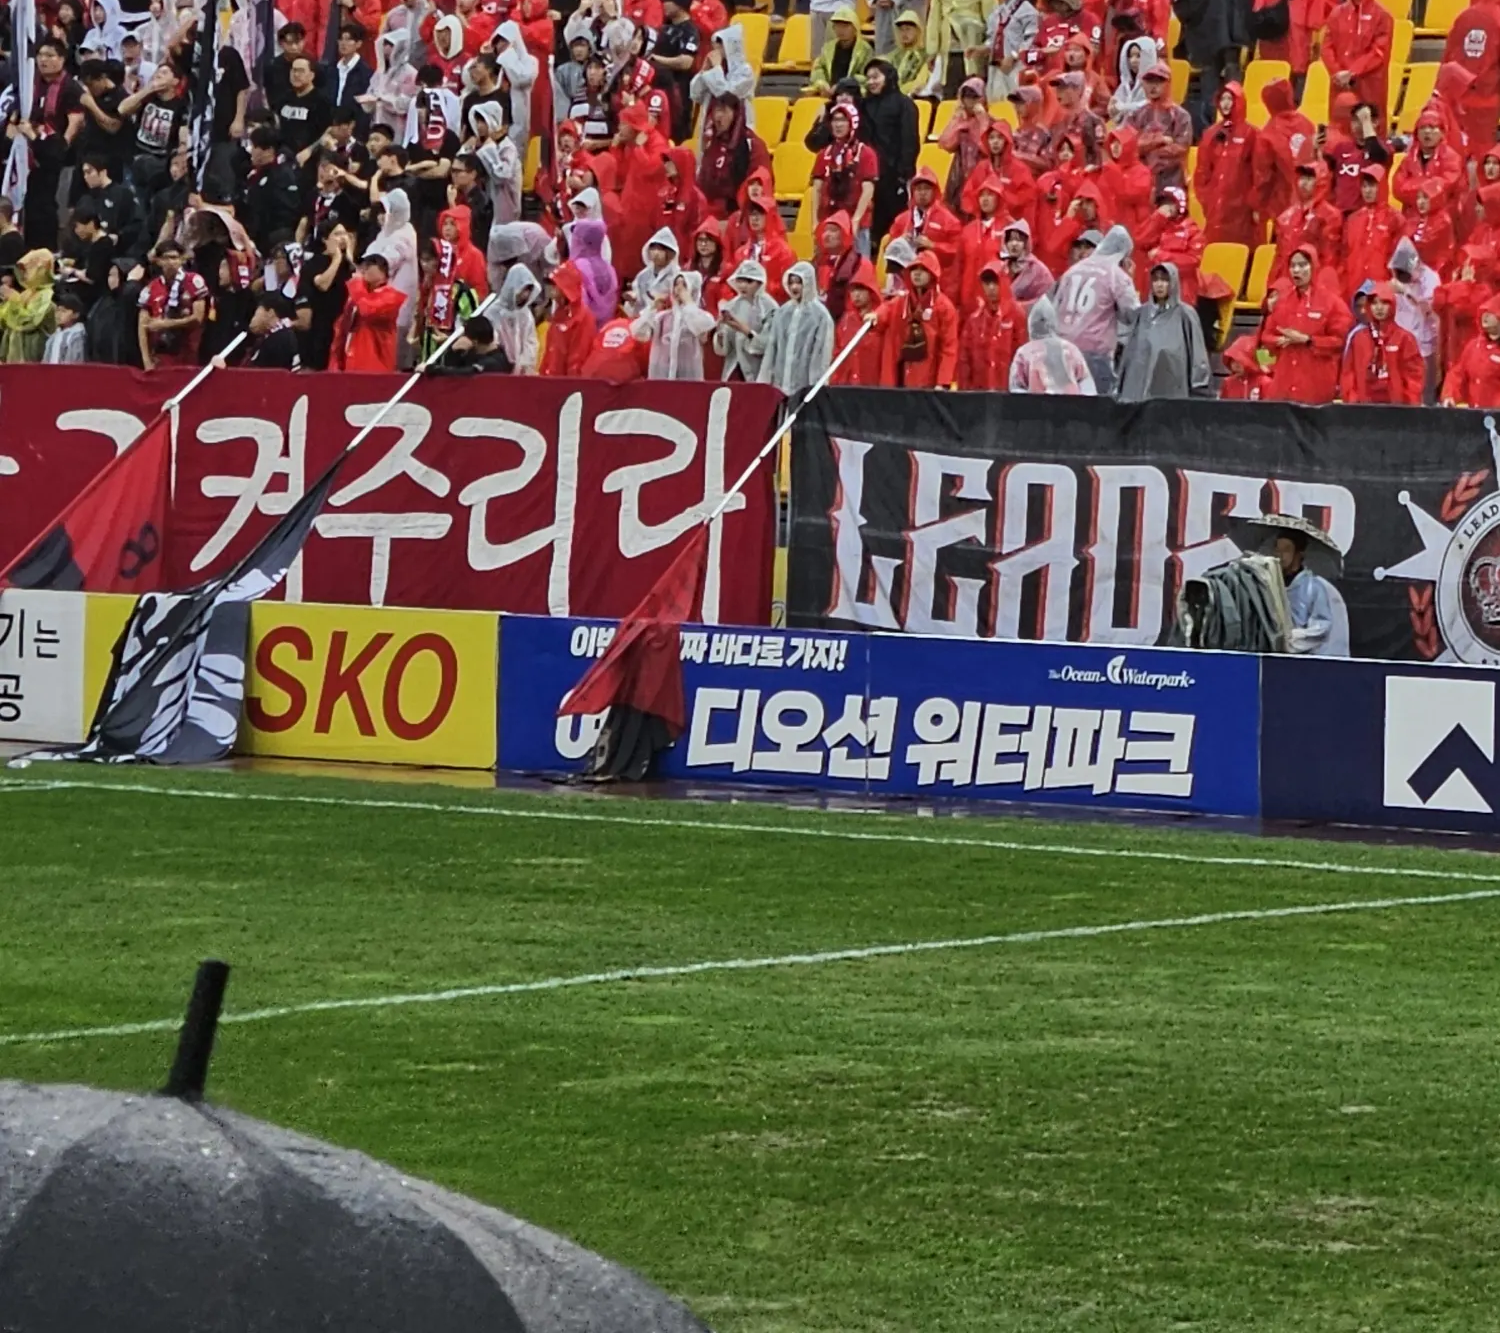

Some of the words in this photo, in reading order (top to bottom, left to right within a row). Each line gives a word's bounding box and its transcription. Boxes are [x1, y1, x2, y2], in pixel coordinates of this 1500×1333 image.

[1066, 274, 1097, 314] 16
[708, 633, 785, 668] 바다로
[786, 637, 848, 672] 가자!
[1061, 665, 1101, 682] Ocean
[1122, 669, 1190, 690] Waterpark
[686, 687, 898, 781] 디오션
[905, 697, 1196, 797] 워터파크
